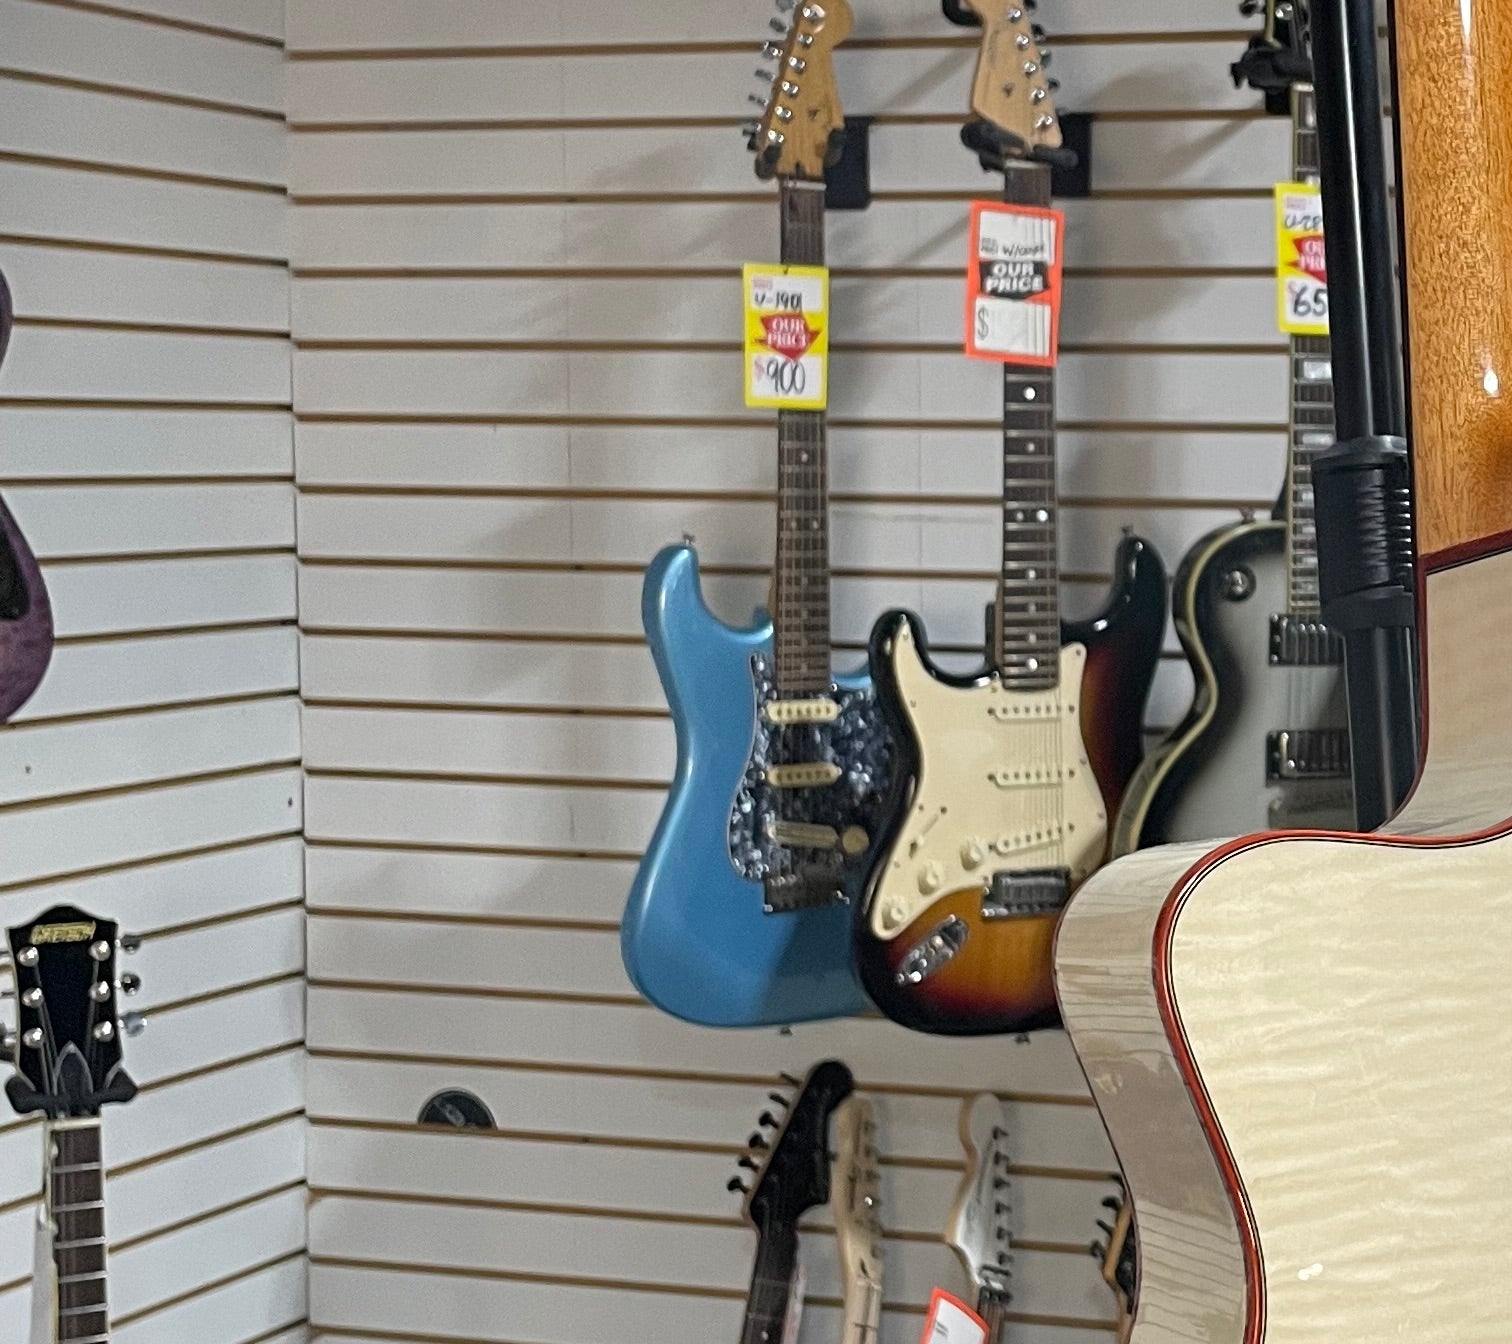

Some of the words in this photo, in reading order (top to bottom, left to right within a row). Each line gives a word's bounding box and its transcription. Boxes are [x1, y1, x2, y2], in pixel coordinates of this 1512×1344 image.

[1303, 240, 1325, 256] OU
[992, 261, 1035, 277] OUR
[1300, 255, 1326, 272] PRI
[985, 275, 1045, 294] PRICE
[772, 317, 806, 333] OUR
[767, 332, 807, 349] PRICE
